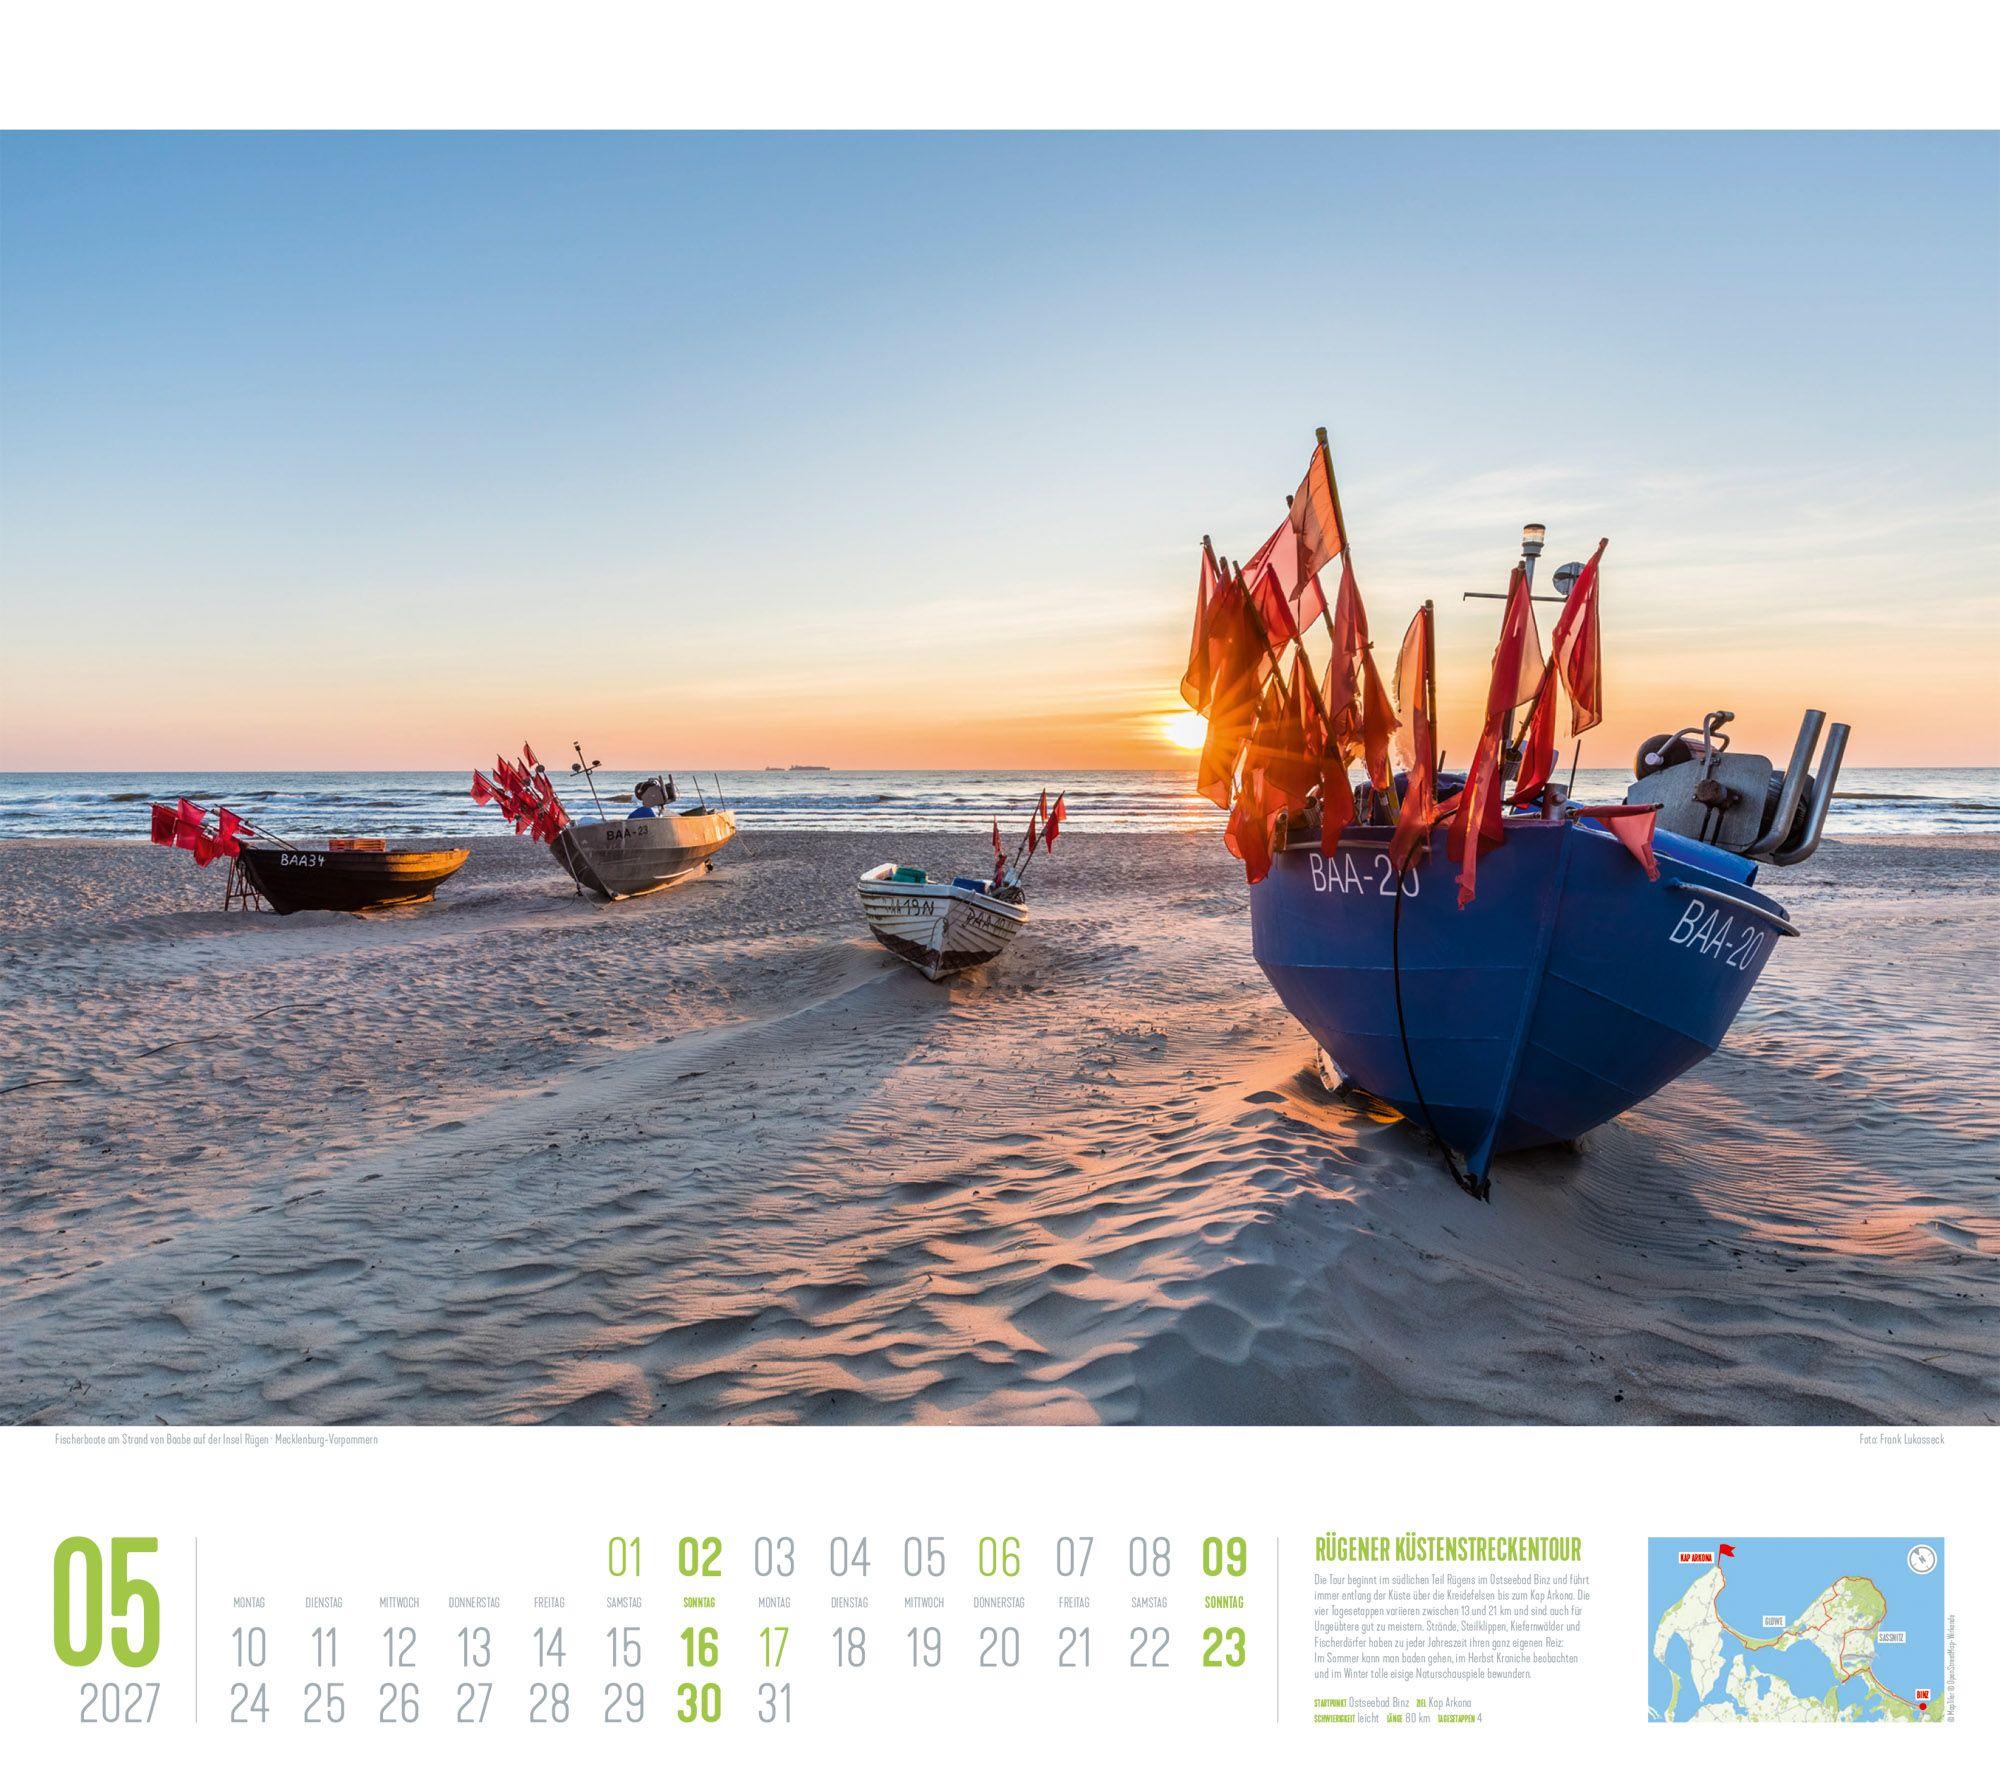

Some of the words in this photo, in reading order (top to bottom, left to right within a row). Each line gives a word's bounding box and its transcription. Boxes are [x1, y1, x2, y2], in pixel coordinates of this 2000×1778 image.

[606, 824, 649, 841] BAA-23
[281, 853, 326, 867] BAA34
[1309, 852, 1420, 898] BAA-20
[1669, 899, 1765, 970] BAA-20
[55, 1434, 106, 1444] Fischerboote
[121, 1433, 149, 1444] Strand
[166, 1434, 191, 1444] Baabe
[193, 1434, 206, 1444] auf
[207, 1434, 221, 1444] der
[222, 1434, 243, 1444] Insel
[244, 1434, 269, 1447] Rügen
[275, 1434, 378, 1447] Mecklenburg-Vorpommern
[1859, 1434, 1878, 1444] Foto:
[1880, 1434, 1902, 1444] Frank
[1904, 1434, 1945, 1444] Lukasseck
[1316, 1532, 1391, 1562] RÜGENER
[1396, 1532, 1582, 1562] KÜSTENSTRECKENTOUR
[608, 1536, 640, 1577] 01
[678, 1536, 722, 1577] 02
[755, 1537, 794, 1576] 03
[831, 1537, 870, 1576] 04
[905, 1537, 945, 1577] 05
[979, 1536, 1021, 1578] 06
[1057, 1537, 1093, 1576] 07
[1130, 1537, 1170, 1576] 08
[1202, 1536, 1248, 1577] 09
[1680, 1554, 1690, 1562] KAP
[1692, 1554, 1712, 1562] ARKONA
[1314, 1574, 1327, 1584] Die
[1329, 1574, 1345, 1584] Tour
[1347, 1574, 1377, 1588] beginnt
[1379, 1576, 1390, 1584] im
[1391, 1574, 1430, 1584] südlichen
[1431, 1574, 1445, 1584] Teil
[1447, 1574, 1476, 1587] Rügens
[1477, 1576, 1488, 1584] im
[1489, 1574, 1532, 1584] Ostseebad
[1533, 1574, 1551, 1584] Binz
[1552, 1574, 1568, 1584] und
[1569, 1574, 1590, 1584] führt
[53, 1536, 160, 1668] 05
[234, 1597, 265, 1608] MONTAG
[306, 1597, 342, 1608] DIENSTAG
[380, 1597, 419, 1608] MITTWOCH
[449, 1597, 499, 1608] DONNERSTAG
[535, 1597, 564, 1608] FREITAG
[607, 1597, 641, 1608] SAMSTAG
[682, 1596, 716, 1608] SONNTAG
[759, 1597, 790, 1608] MONTAG
[832, 1597, 868, 1608] DIENSTAG
[905, 1597, 944, 1608] MITTWOCH
[974, 1597, 1024, 1608] DONNERSTAG
[1059, 1597, 1089, 1608] FREITAG
[1132, 1597, 1167, 1608] SAMSTAG
[1205, 1595, 1244, 1608] SONNTAG
[1314, 1592, 1340, 1600] immer
[1341, 1590, 1372, 1603] entlang
[1373, 1590, 1386, 1600] der
[1388, 1589, 1411, 1600] Küste
[1413, 1590, 1431, 1600] über
[1432, 1590, 1445, 1600] die
[1446, 1590, 1495, 1600] Kreidefelsen
[1497, 1590, 1510, 1600] bis
[1530, 1590, 1546, 1602] Kap
[1546, 1590, 1576, 1600] Arkona.
[1577, 1589, 1591, 1600] Die
[1314, 1607, 1329, 1615] vier
[1331, 1605, 1385, 1618] Tagesetappen
[1386, 1607, 1420, 1615] variieren
[1421, 1605, 1459, 1615] zwischen
[1460, 1605, 1470, 1615] 13
[1471, 1606, 1487, 1615] und
[1488, 1606, 1498, 1615] 21
[1499, 1606, 1512, 1615] km
[1513, 1605, 1529, 1615] und
[1530, 1606, 1548, 1615] sind
[1549, 1605, 1569, 1615] auch
[1571, 1605, 1583, 1615] für
[1314, 1621, 1360, 1634] Ungeübtere
[1361, 1624, 1375, 1634] gut
[1387, 1623, 1425, 1631] meistern.
[1426, 1620, 1460, 1632] Strände,
[1460, 1620, 1509, 1634] Steilklippen,
[1510, 1620, 1564, 1631] Kiefernwälder
[1566, 1621, 1581, 1631] und
[1765, 1617, 1783, 1626] GLOWE
[1314, 1637, 1367, 1647] Fischerdörfer
[1368, 1637, 1393, 1647] haben
[1405, 1637, 1426, 1649] jeder
[1427, 1637, 1468, 1647] Jahreszeit
[1469, 1637, 1491, 1647] ihren
[1491, 1640, 1511, 1650] ganz
[1512, 1640, 1543, 1650] eigenen
[1879, 1633, 1904, 1642] SASSNITZ
[233, 1627, 265, 1667] 10
[312, 1627, 335, 1667] 11
[384, 1627, 416, 1667] 12
[458, 1627, 490, 1667] 13
[534, 1627, 566, 1667] 14
[607, 1627, 641, 1667] 15
[680, 1627, 718, 1668] 16
[760, 1626, 789, 1667] 17
[833, 1627, 865, 1667] 18
[908, 1627, 941, 1667] 19
[980, 1627, 1019, 1667] 20
[1059, 1627, 1089, 1667] 21
[1130, 1627, 1169, 1667] 22
[1202, 1626, 1246, 1668] 23
[1314, 1652, 1325, 1662] Im
[1326, 1652, 1359, 1663] Sommer
[1361, 1653, 1380, 1663] kann
[1401, 1653, 1426, 1663] baden
[1427, 1653, 1454, 1666] gehen,
[1455, 1654, 1466, 1662] im
[1468, 1653, 1494, 1663] Herbst
[1496, 1652, 1531, 1663] Kraniche
[1533, 1652, 1579, 1663] beobachten
[1314, 1668, 1329, 1678] und
[1331, 1670, 1342, 1678] im
[1343, 1668, 1369, 1678] Winter
[1370, 1668, 1389, 1678] tolle
[1390, 1672, 1414, 1681] eisige
[1415, 1668, 1485, 1681] Naturschauspiele
[1487, 1668, 1532, 1679] bewundern.
[1916, 1690, 1929, 1699] BINZ
[81, 1683, 160, 1722] 2027
[231, 1683, 269, 1722] 24
[304, 1683, 344, 1723] 25
[380, 1683, 418, 1723] 26
[458, 1683, 492, 1722] 27
[530, 1683, 569, 1723] 28
[605, 1683, 644, 1722] 29
[677, 1682, 721, 1723] 30
[759, 1683, 790, 1723] 31
[1313, 1698, 1348, 1708] STARTPUNKT
[1348, 1697, 1390, 1707] Ostseebad
[1392, 1697, 1410, 1707] Binz
[1415, 1698, 1428, 1707] ZIEL
[1428, 1697, 1444, 1710] Kap
[1445, 1697, 1472, 1707] Arkona
[1313, 1714, 1356, 1724] SCHWIERIGKEIT
[1357, 1712, 1379, 1723] leicht
[1386, 1713, 1404, 1723] LÄNGE
[1405, 1713, 1417, 1722] 80
[1418, 1713, 1431, 1722] km
[1436, 1713, 1476, 1724] TAGESETAPPEN
[1476, 1713, 1483, 1722] 4
